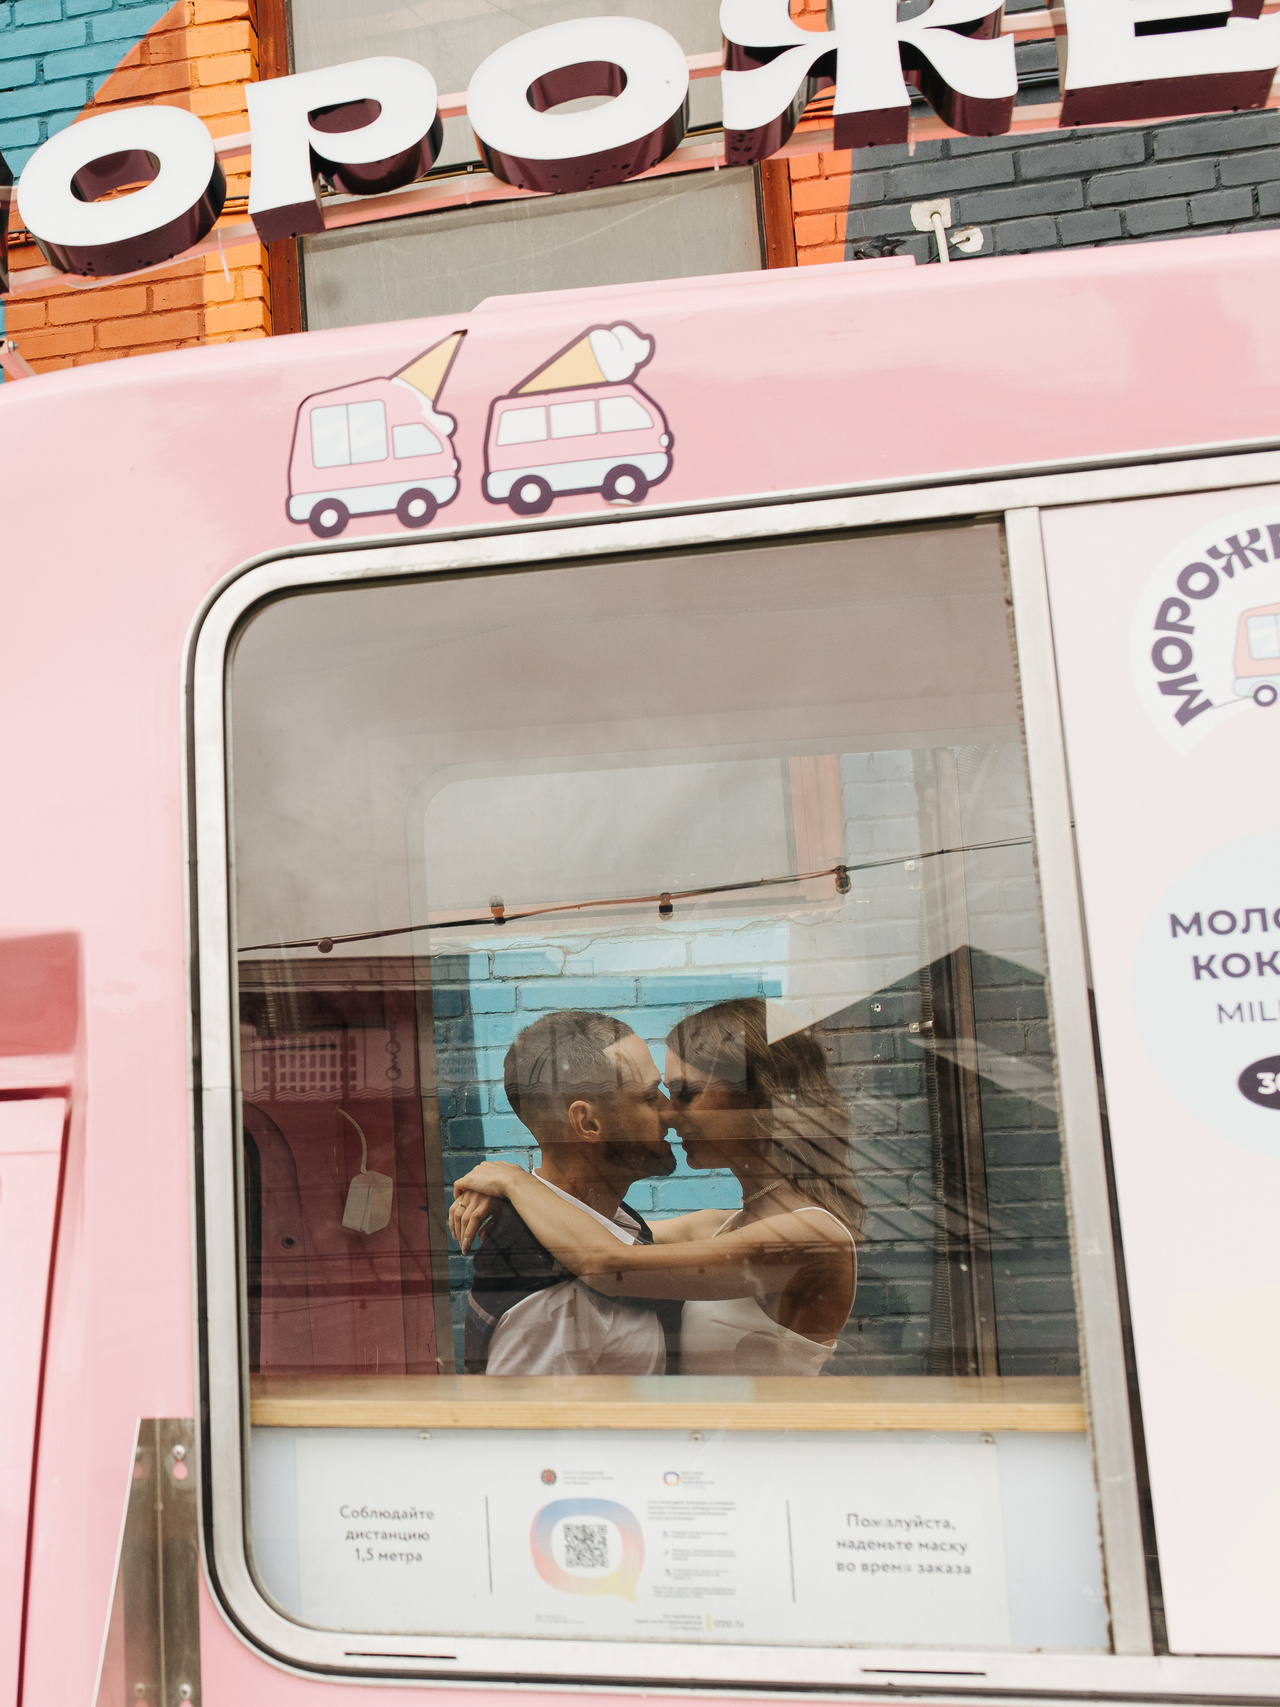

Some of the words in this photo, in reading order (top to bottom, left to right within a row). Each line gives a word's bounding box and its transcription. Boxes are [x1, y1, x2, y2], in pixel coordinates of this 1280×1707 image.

[1170, 908, 1280, 938] МОЛ
[1217, 1000, 1280, 1024] MIL
[339, 1505, 435, 1521] Соблюдайте
[846, 1512, 957, 1533] Пожалуйста,
[345, 1529, 430, 1542] дистанцию
[354, 1547, 375, 1563] 1,5
[378, 1552, 423, 1566] метра
[836, 1539, 914, 1552] наденьте
[918, 1541, 968, 1556] маску
[836, 1561, 857, 1573] во
[918, 1564, 973, 1576] заказа
